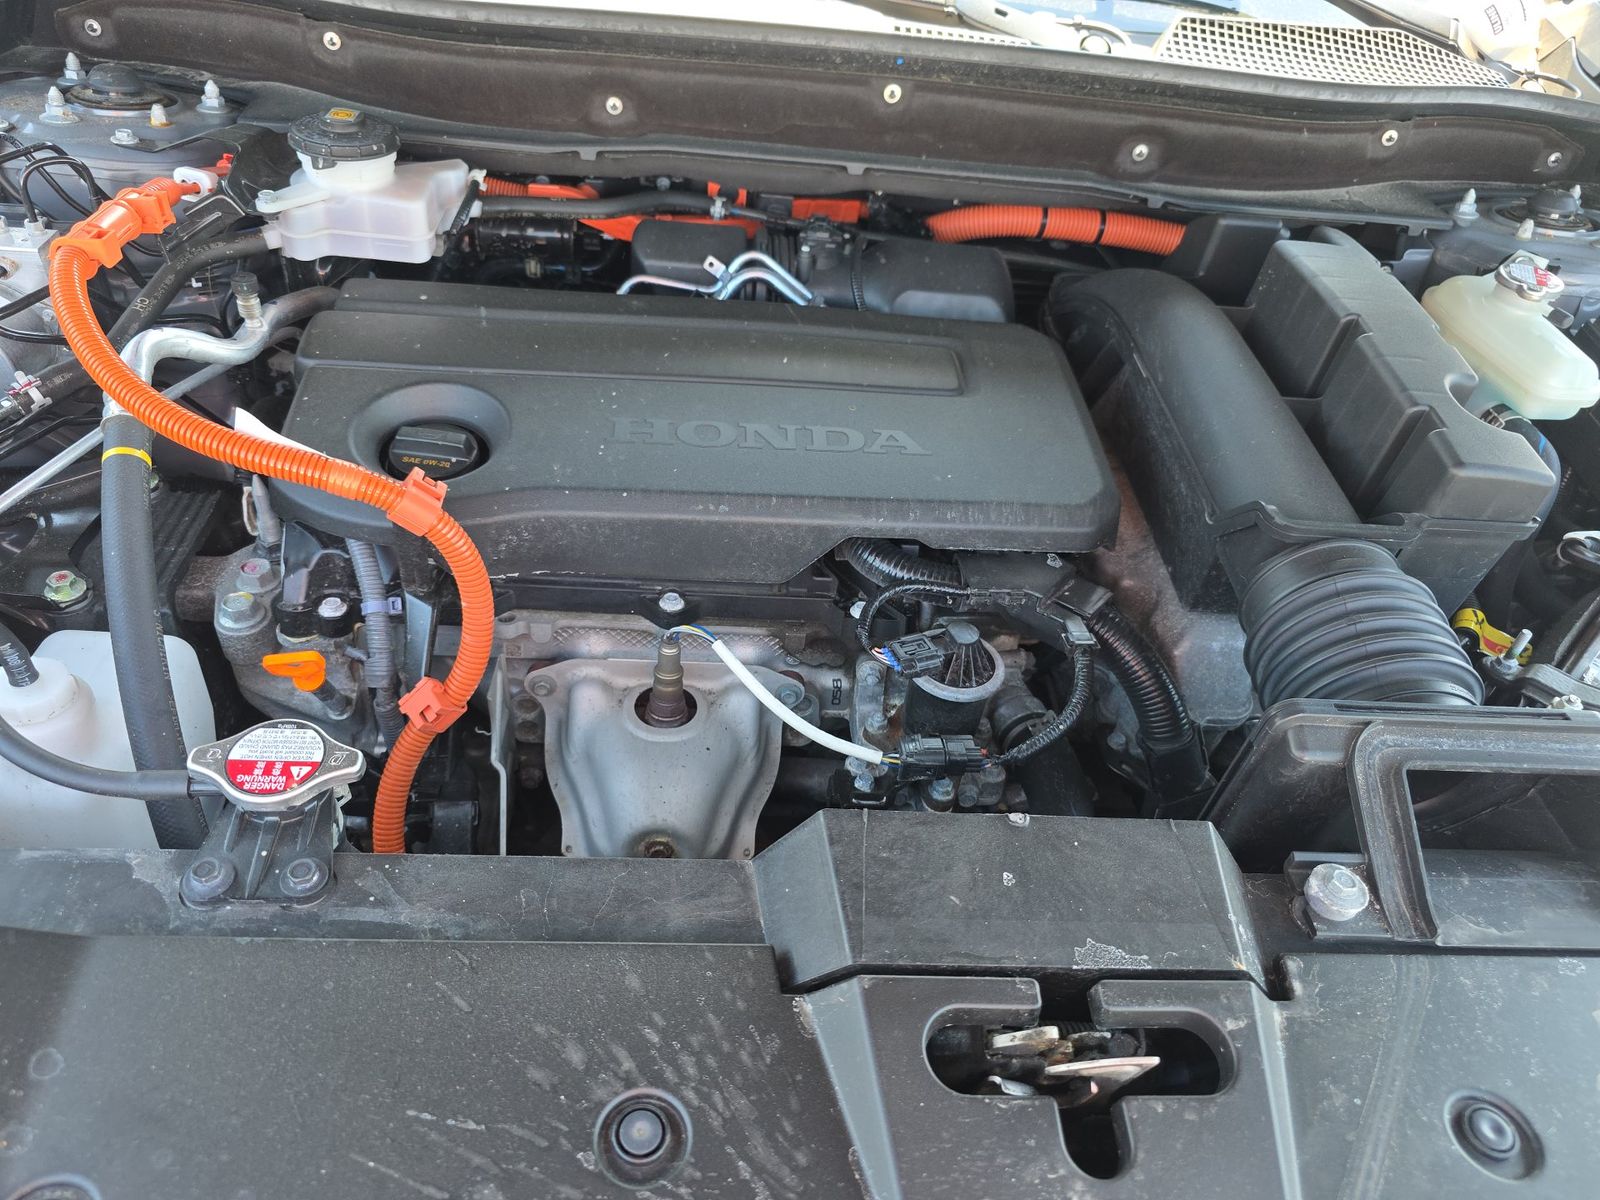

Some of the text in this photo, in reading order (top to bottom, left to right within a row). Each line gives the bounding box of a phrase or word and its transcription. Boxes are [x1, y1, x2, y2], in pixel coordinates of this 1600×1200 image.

[1485, 4, 1503, 35] ULINE
[132, 297, 150, 312] CH
[605, 416, 933, 456] HONDA
[401, 455, 452, 469] SAE 0W-20
[236, 774, 287, 783] WARNUNG
[243, 781, 285, 790] DANGER
